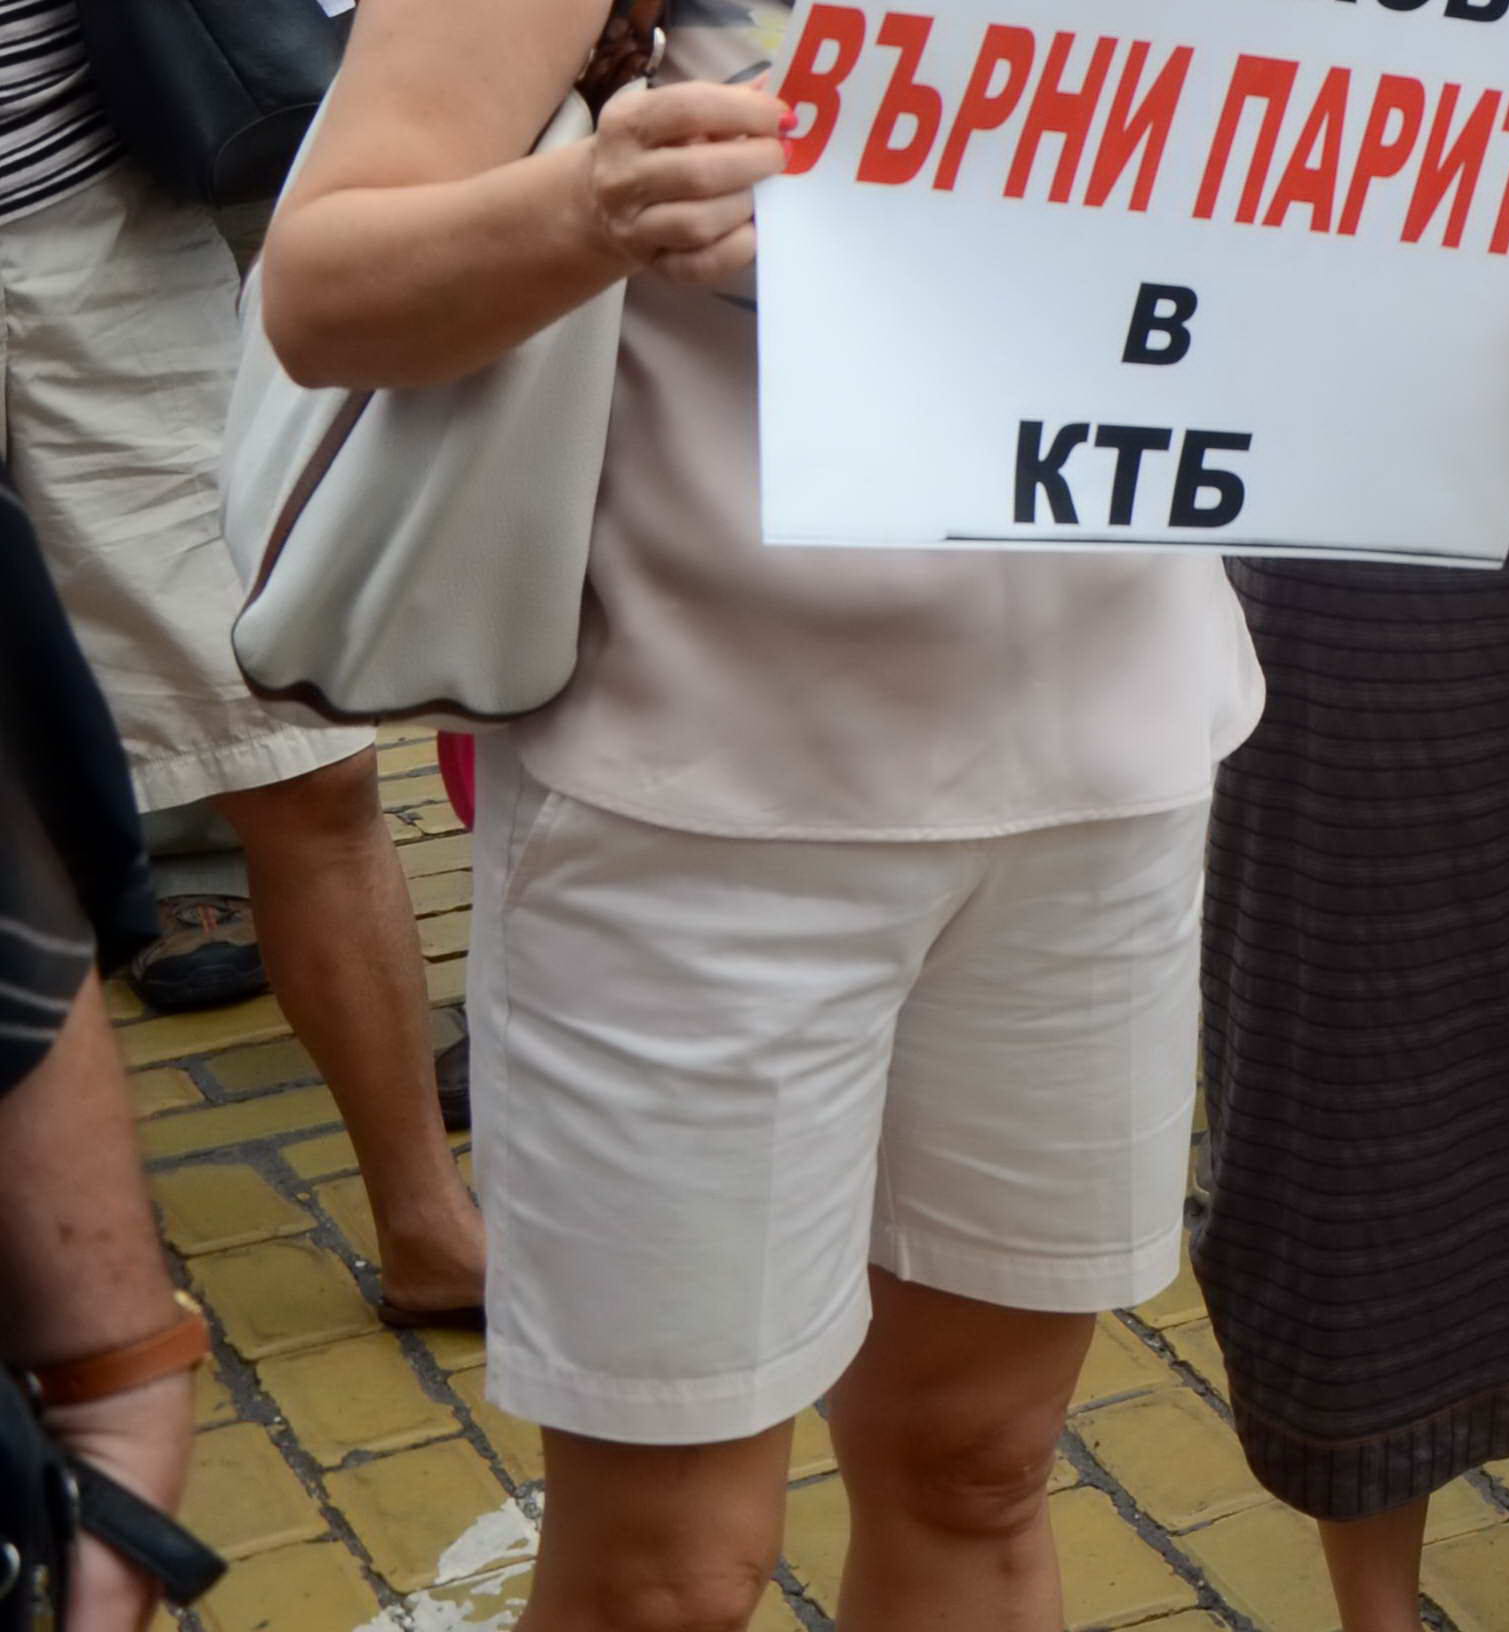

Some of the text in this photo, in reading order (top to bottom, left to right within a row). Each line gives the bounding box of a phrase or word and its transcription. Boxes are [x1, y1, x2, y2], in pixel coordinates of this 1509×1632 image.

[776, 2, 1196, 213] ВЪРНИ
[1121, 281, 1199, 367] В
[1013, 419, 1254, 529] КТБ
